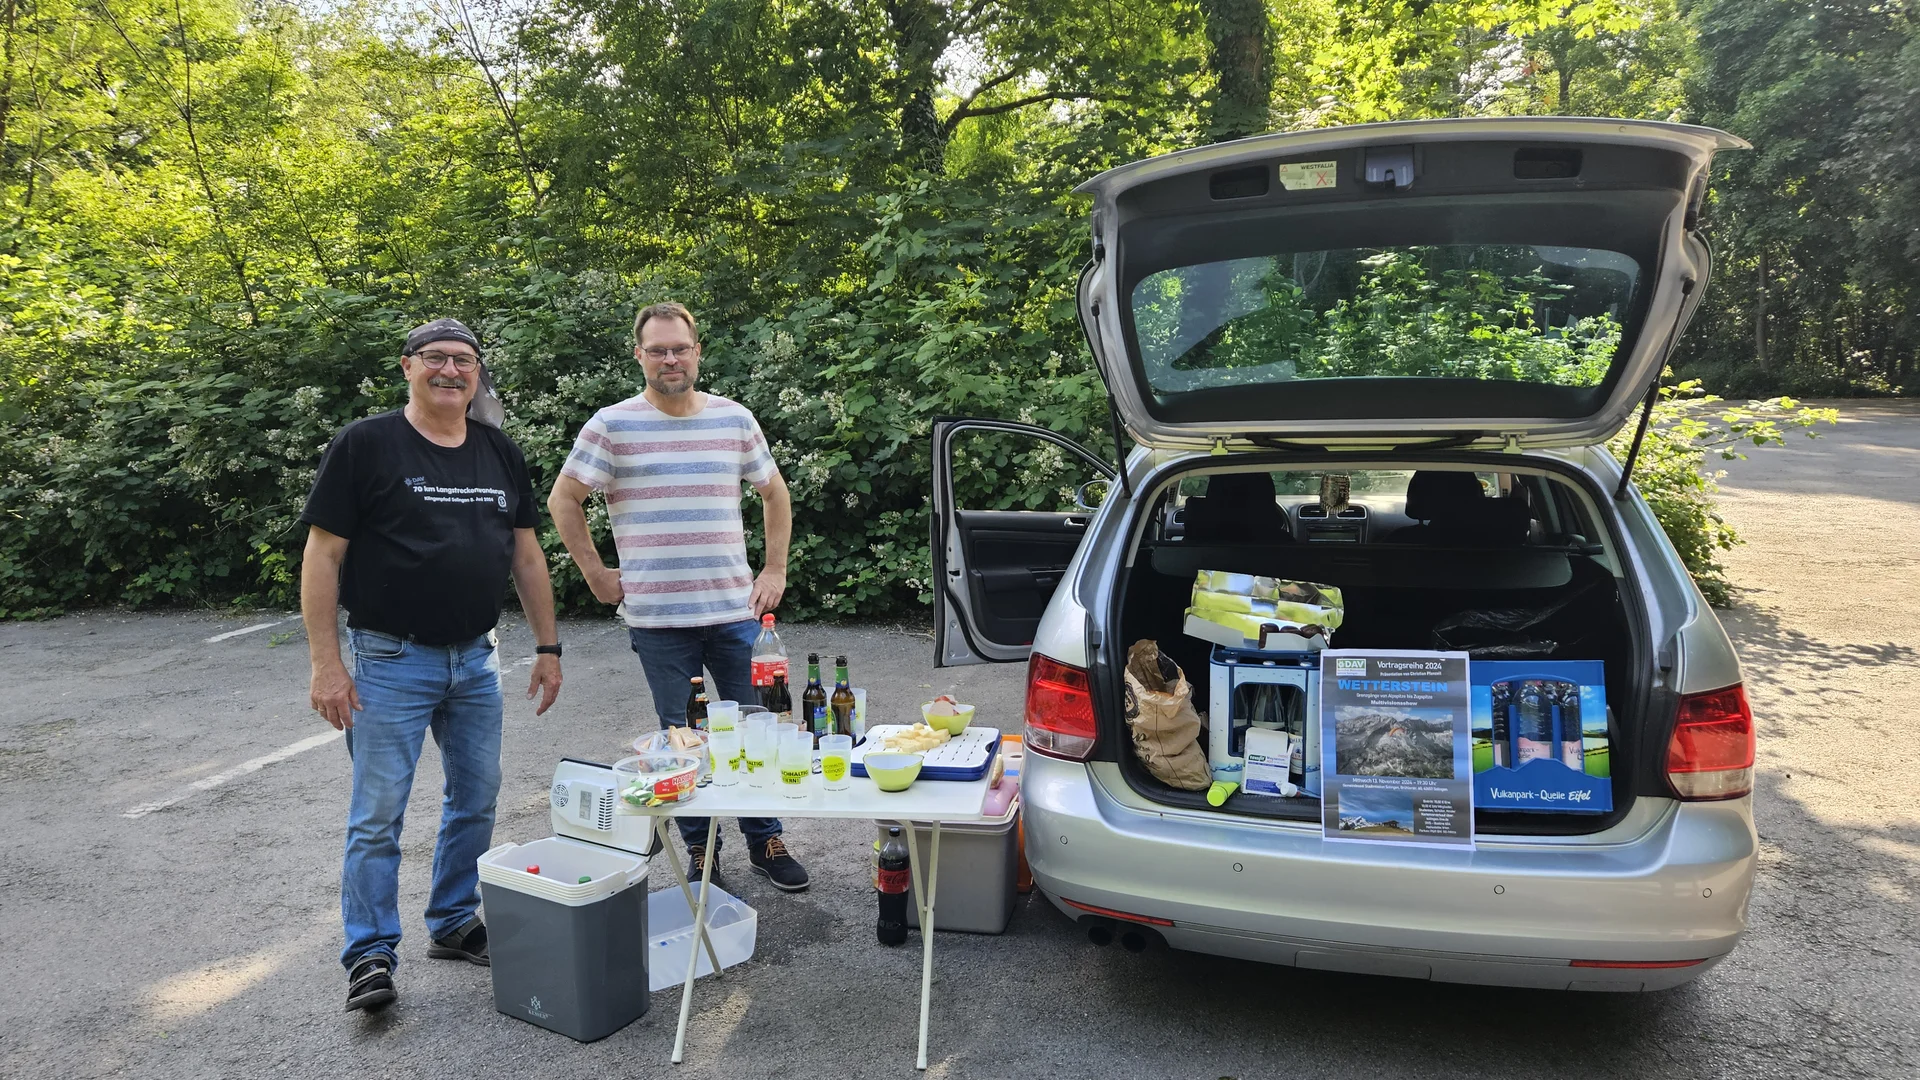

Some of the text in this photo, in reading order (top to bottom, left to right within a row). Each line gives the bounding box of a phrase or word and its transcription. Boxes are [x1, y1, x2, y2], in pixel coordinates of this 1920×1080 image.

[1345, 660, 1364, 668] DAV
[1377, 661, 1424, 670] Vortragsreihe
[1337, 680, 1448, 692] WETTERSTEIN
[1568, 790, 1591, 802] Eifel
